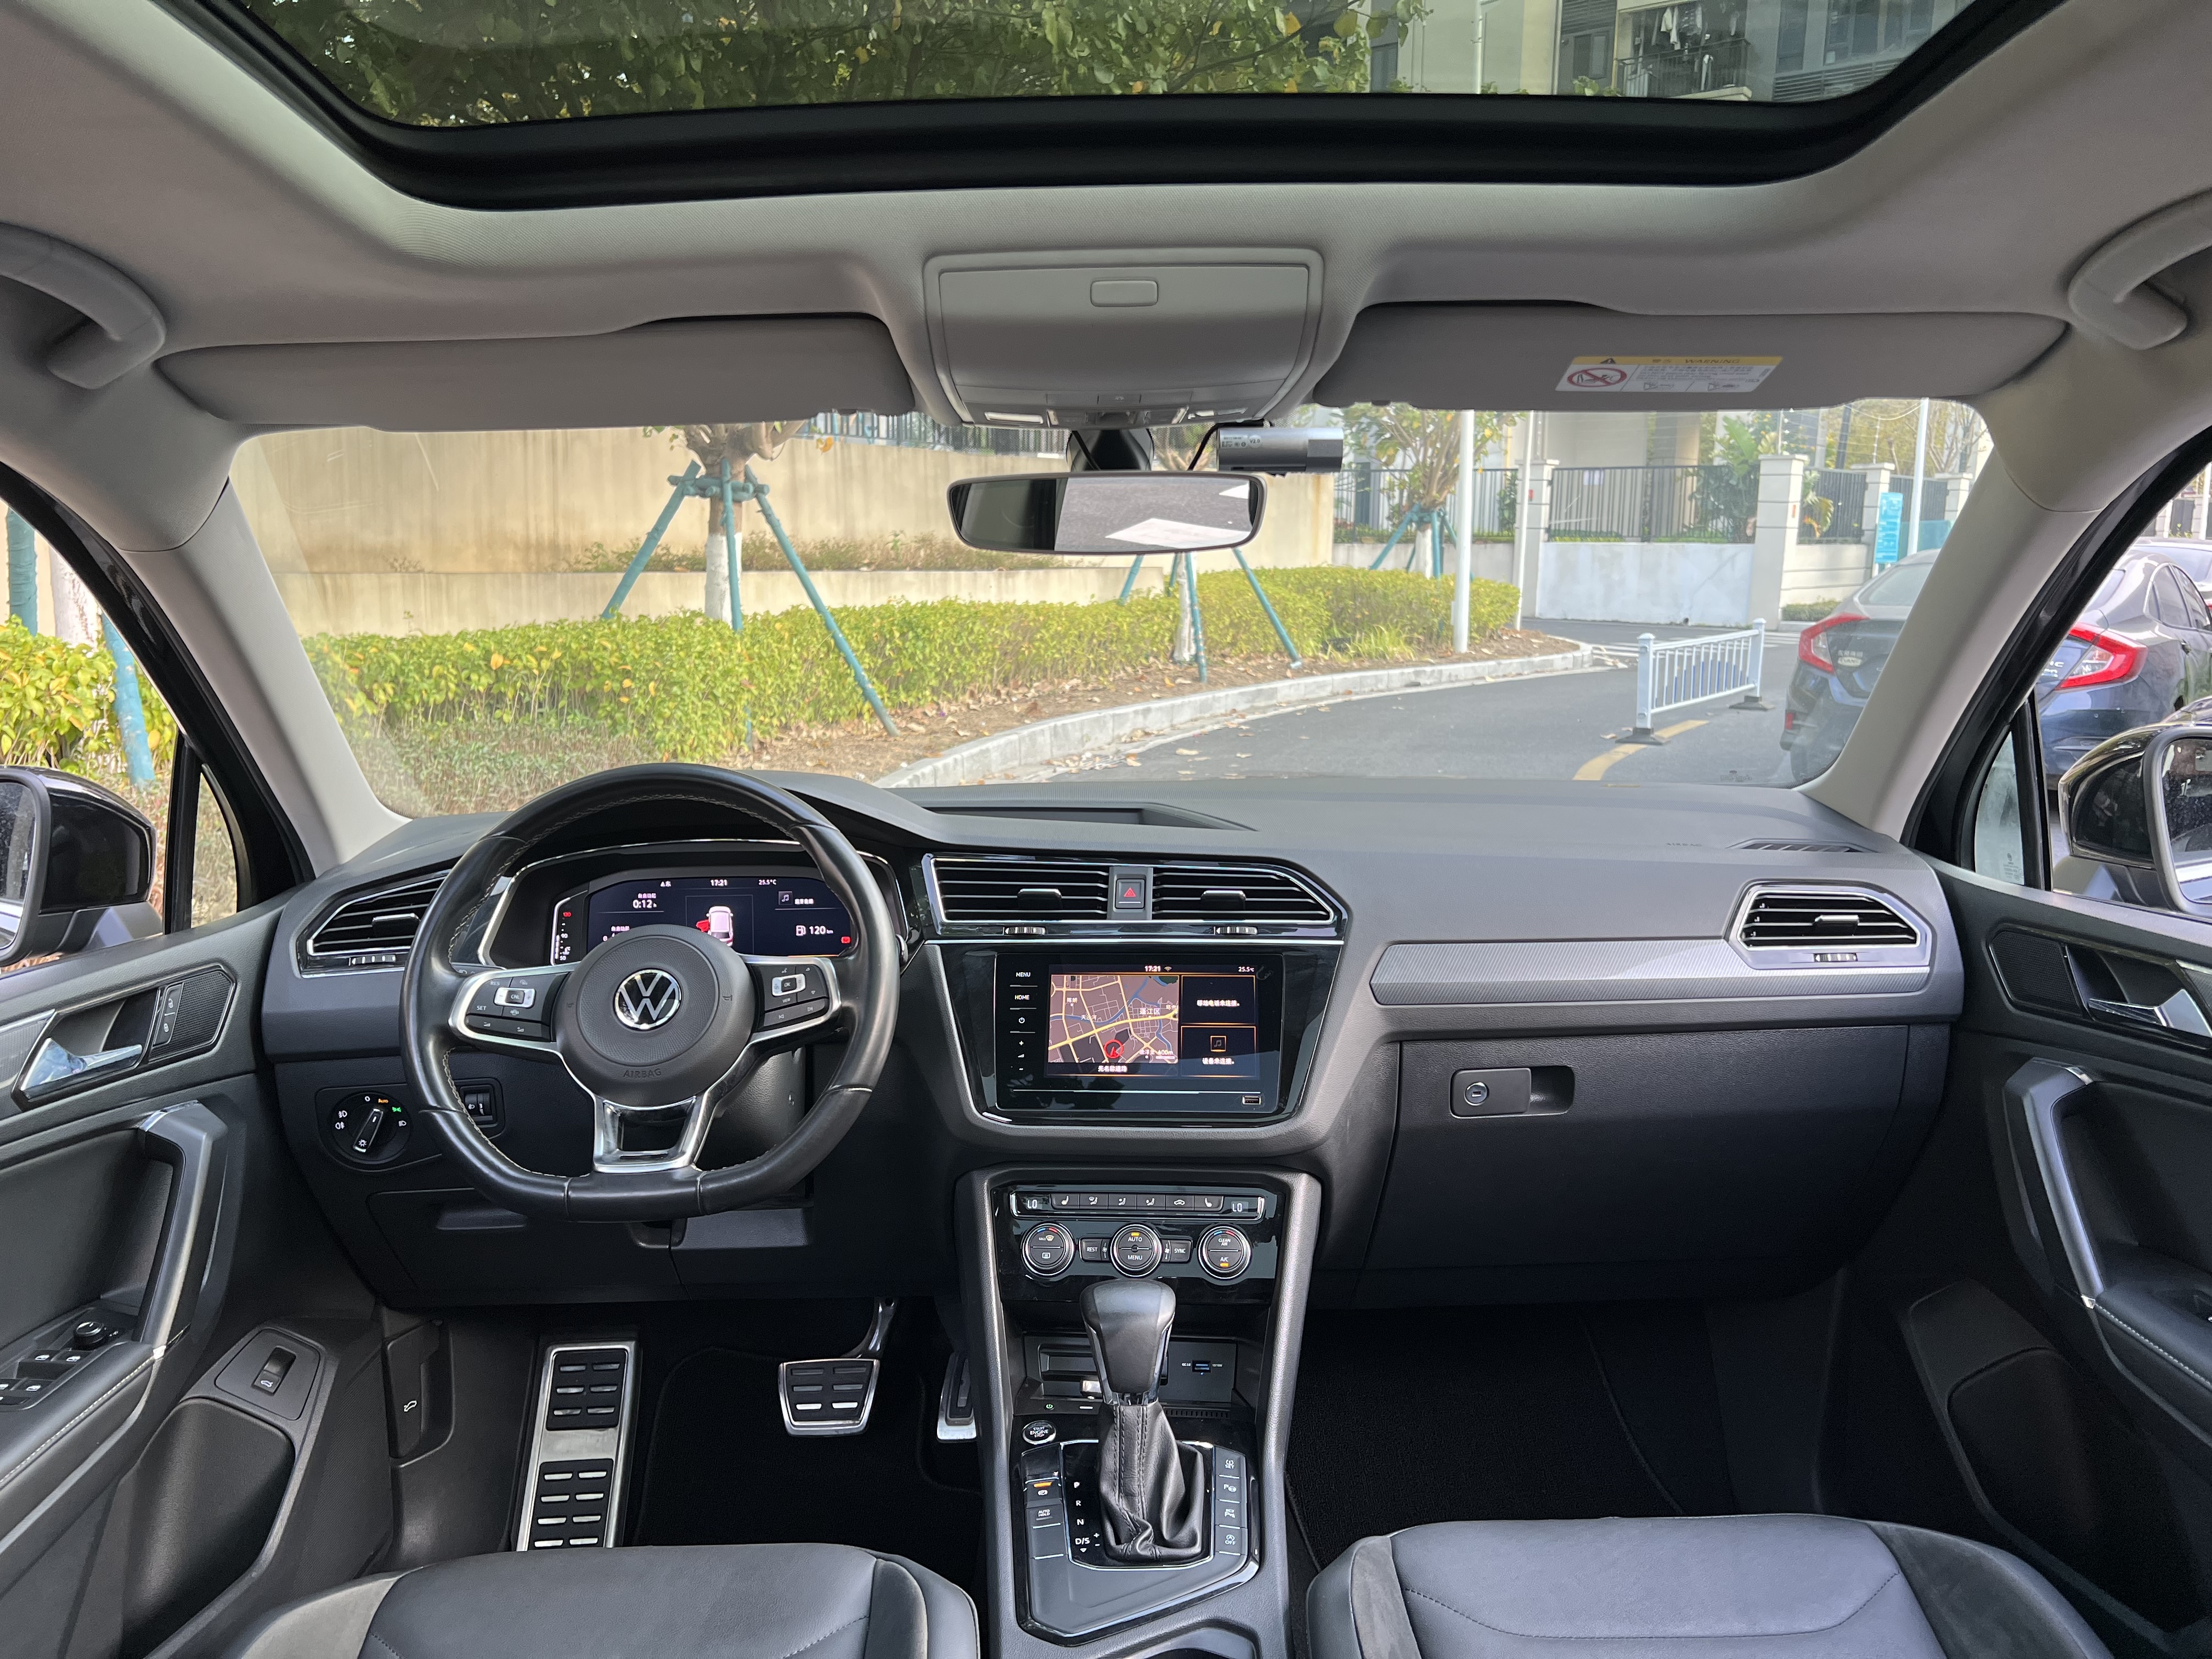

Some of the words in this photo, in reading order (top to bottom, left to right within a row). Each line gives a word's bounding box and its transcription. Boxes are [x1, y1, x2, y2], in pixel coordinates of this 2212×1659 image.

[633, 900, 652, 909] 0:12
[809, 926, 826, 934] 120
[623, 1069, 661, 1078] AIRBAG
[1027, 1199, 1037, 1209] LO
[1232, 1203, 1242, 1212] LO
